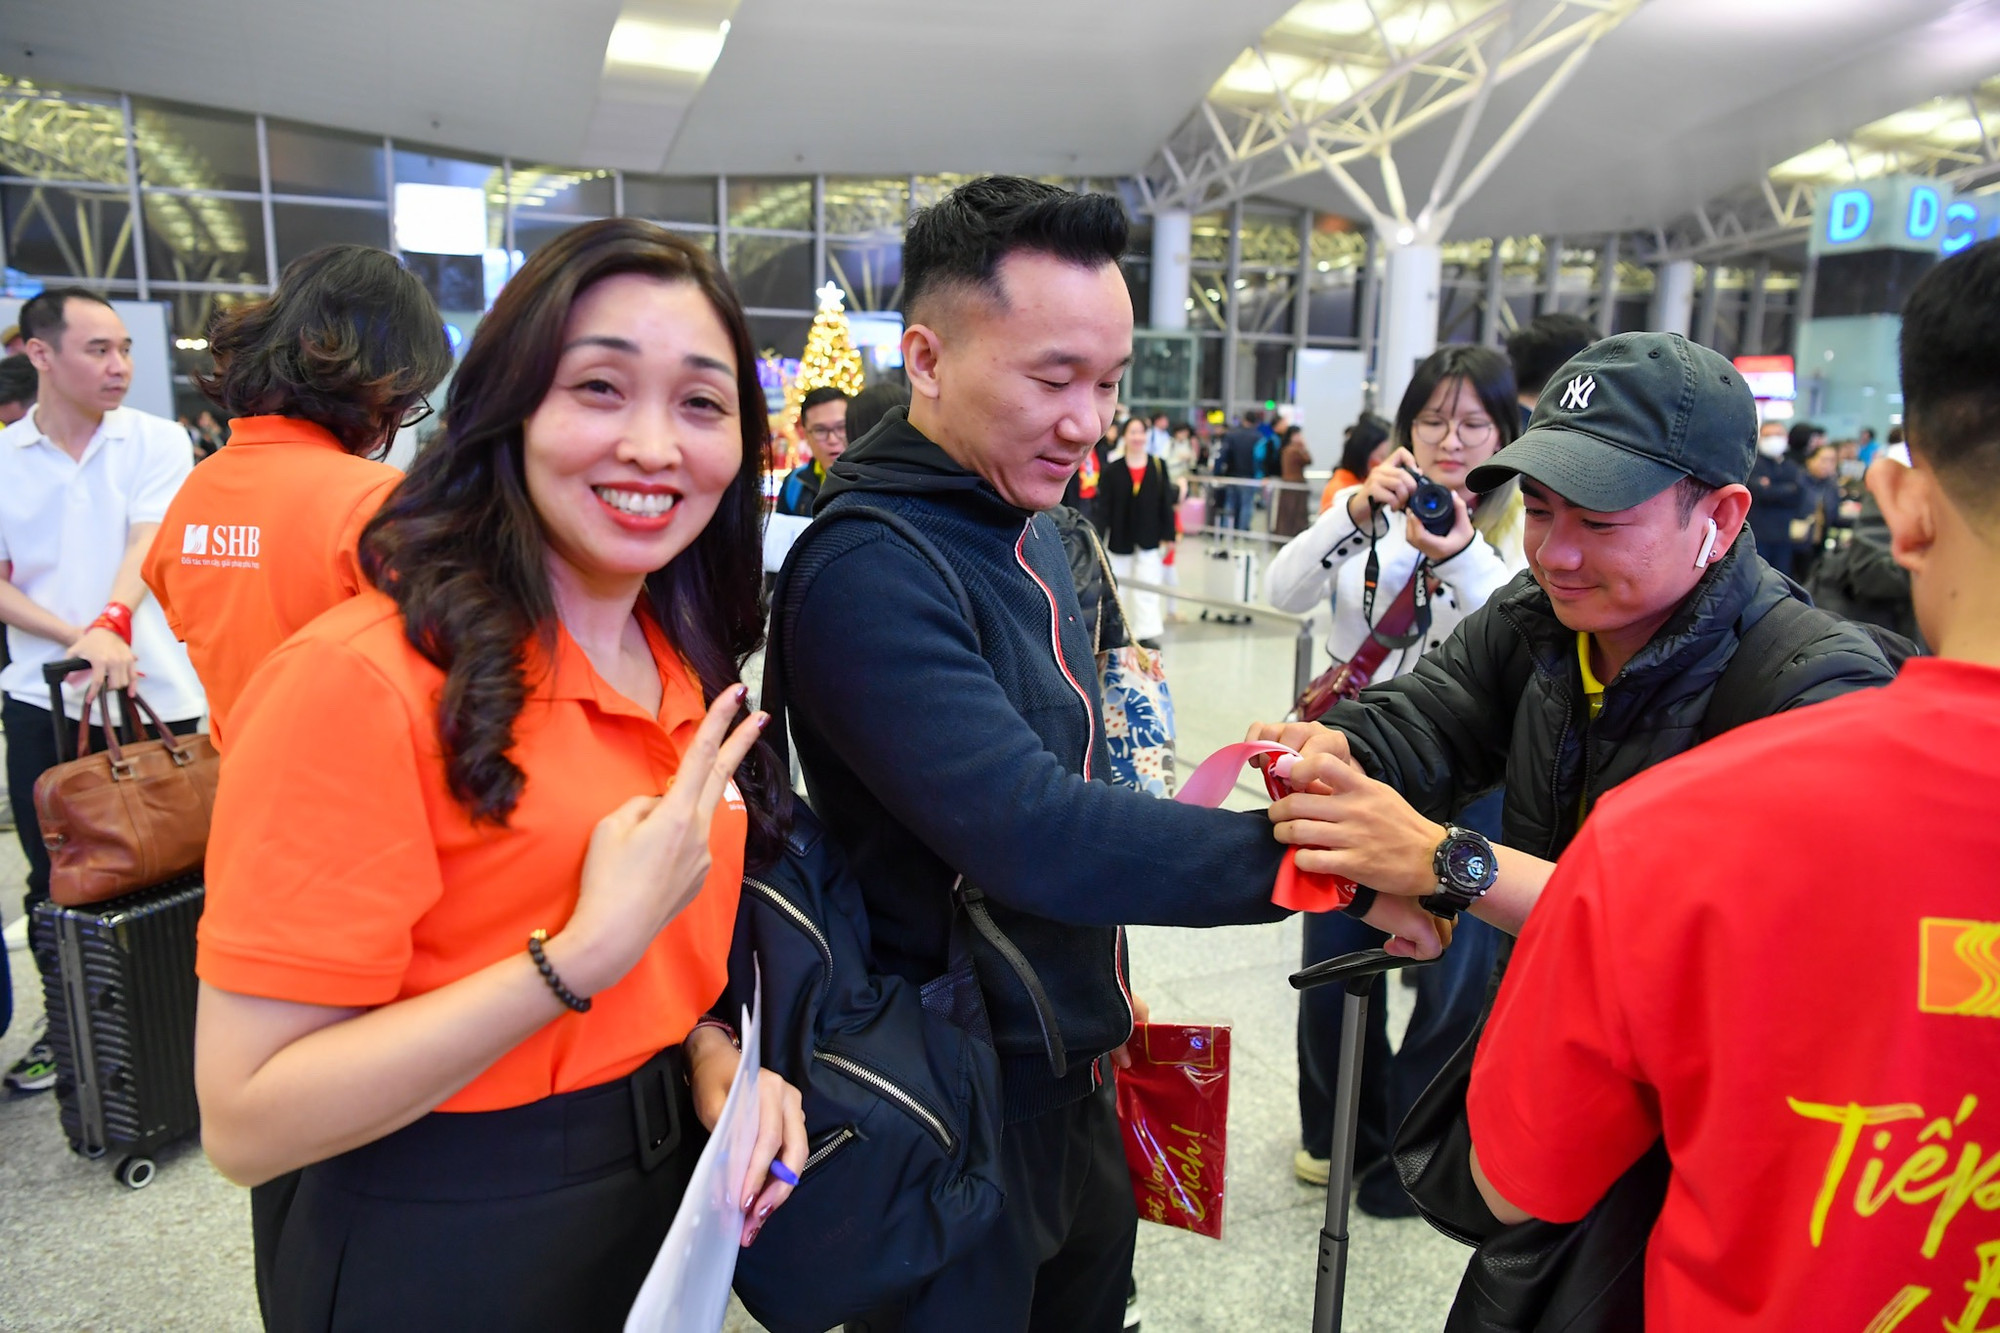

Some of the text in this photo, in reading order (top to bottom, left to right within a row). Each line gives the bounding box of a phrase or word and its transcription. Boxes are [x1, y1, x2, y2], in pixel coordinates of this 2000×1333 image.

[1828, 189, 1872, 243] D
[1906, 186, 1940, 239] D
[1559, 374, 1596, 409] NY
[211, 524, 260, 558] SHB
[1786, 1092, 2000, 1260] Tiếp
